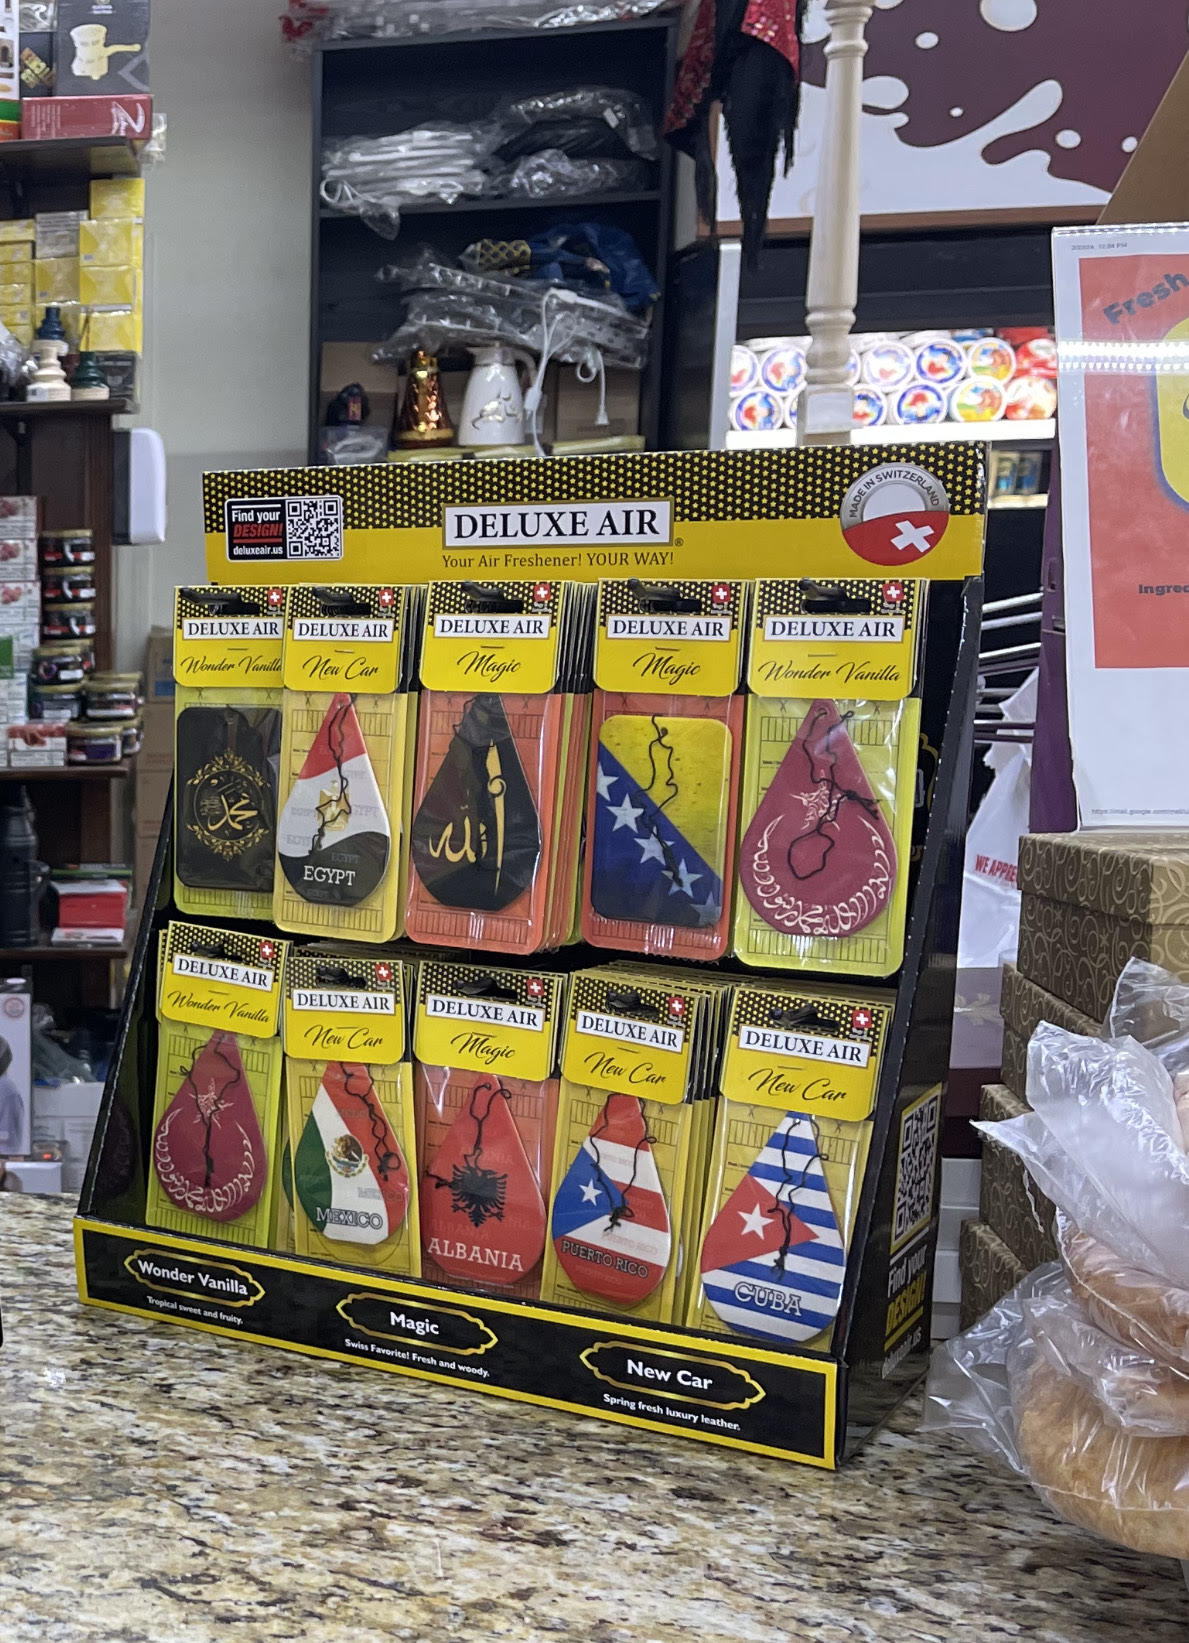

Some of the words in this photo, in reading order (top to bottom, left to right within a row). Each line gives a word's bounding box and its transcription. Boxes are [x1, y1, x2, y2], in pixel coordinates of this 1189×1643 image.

[1103, 273, 1189, 325] Fresh
[849, 488, 866, 518] MADE
[864, 478, 876, 490] IN
[875, 470, 940, 506] SWITZERLAND
[232, 509, 254, 523] Find
[256, 511, 282, 524] your
[233, 522, 283, 537] DESIGN!
[454, 511, 590, 539] DELUXE
[596, 509, 661, 536] AIR
[233, 545, 284, 557] deluxeair.us
[442, 554, 475, 568] Your
[478, 554, 500, 567] Air
[504, 553, 582, 567] Freshener!
[586, 552, 629, 566] YOUR
[634, 551, 674, 566] WAY!
[188, 621, 250, 636] DELUXE
[253, 622, 280, 636] AIR
[298, 623, 360, 638] DELUXE
[362, 624, 389, 638] AIR
[440, 619, 511, 634] DELUXE
[513, 620, 545, 635] AIR
[613, 619, 688, 636] DELUXE
[691, 621, 724, 637] AIR
[771, 620, 854, 638] DELUXE
[860, 621, 896, 638] AIR
[180, 655, 236, 674] Wonder
[302, 655, 341, 681] New
[344, 656, 379, 680] Car
[456, 651, 522, 683] Magic
[632, 652, 701, 686] Magic
[757, 659, 831, 683] Wonder
[835, 660, 902, 683] Vanilla
[303, 865, 356, 886] EGYPT
[976, 854, 990, 874] WE
[178, 958, 239, 982] DELUXE
[242, 972, 268, 988] AIR
[167, 990, 221, 1013] Wonder
[223, 1001, 270, 1024] Vanilla
[297, 993, 360, 1009] DELUXE
[362, 996, 390, 1011] AIR
[432, 999, 504, 1022] DELUXE
[506, 1010, 538, 1027] AIR
[304, 1024, 344, 1049] New
[347, 1028, 383, 1049] Car
[581, 1014, 648, 1042] DELUXE
[649, 1032, 678, 1048] AIR
[450, 1032, 516, 1066] Magic
[745, 1030, 824, 1057] DELUXE
[827, 1044, 862, 1063] AIR
[584, 1052, 626, 1079] New
[628, 1062, 667, 1085] Car
[748, 1068, 801, 1096] New
[801, 1078, 847, 1102] Car
[315, 1206, 384, 1230] MEXICO
[427, 1236, 524, 1273] ALBANIA
[561, 1239, 613, 1267] PUERTO
[615, 1257, 649, 1278] RICO
[137, 1259, 195, 1284] Wonder
[197, 1272, 248, 1296] Vanilla
[887, 1256, 907, 1299] Find
[907, 1243, 928, 1285] your
[147, 1295, 178, 1310] Tropical
[179, 1303, 202, 1315] sweet
[203, 1308, 218, 1319] and
[219, 1311, 244, 1325] fruity.
[734, 1281, 802, 1317] CUBA
[390, 1311, 440, 1336] Magic
[344, 1338, 369, 1351] Swiss
[370, 1343, 410, 1360] Favorite!
[412, 1352, 437, 1366] Fresh
[439, 1358, 456, 1370] and
[458, 1362, 490, 1378] woody.
[627, 1359, 672, 1382] New
[676, 1369, 713, 1390] Car
[603, 1392, 636, 1411] Spring
[637, 1400, 664, 1415] fresh
[665, 1406, 699, 1424] luxury
[700, 1413, 741, 1431] leather.
